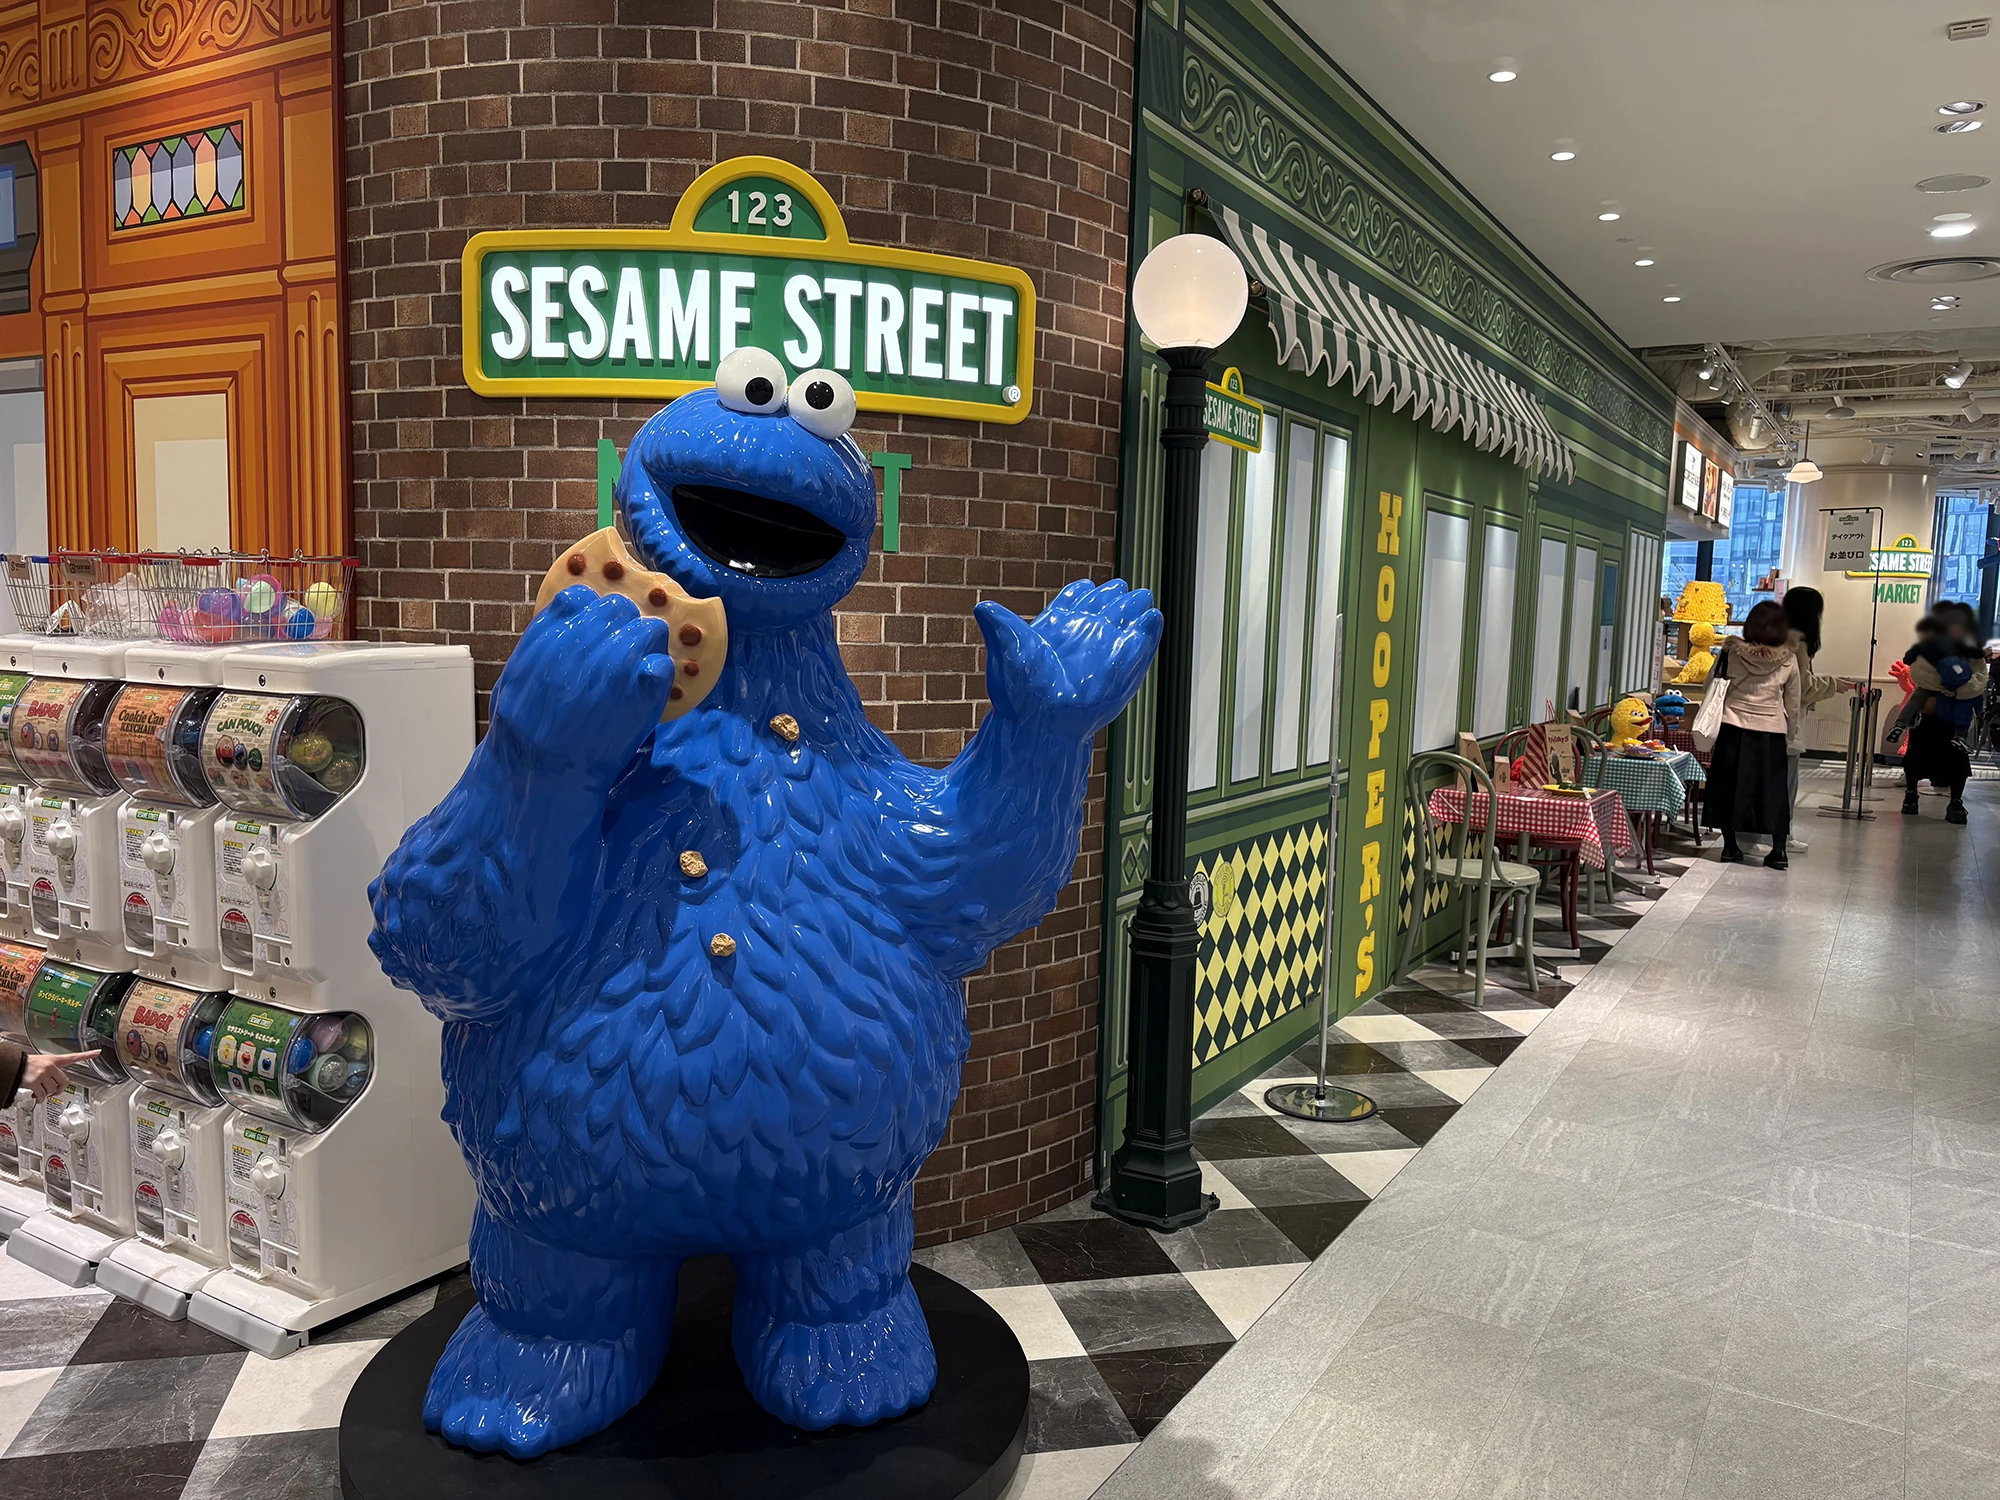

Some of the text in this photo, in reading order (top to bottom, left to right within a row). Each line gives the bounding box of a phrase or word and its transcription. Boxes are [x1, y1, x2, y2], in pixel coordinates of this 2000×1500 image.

[728, 190, 793, 228] 123
[490, 263, 1014, 386] SESAME STREET
[1203, 394, 1260, 442] SESAME STREET
[1831, 533, 1865, 541] テイクアウト
[1901, 539, 1913, 547] 123
[1829, 551, 1864, 560] お並び口
[1869, 552, 1907, 571] SAME
[1872, 583, 1922, 604] MARKET
[27, 700, 65, 720] BADGE
[118, 710, 165, 726] Cookie Can
[120, 722, 157, 735] KEYCHAIN
[216, 718, 265, 737] CAN POUCH
[133, 1005, 174, 1032] BADGE
